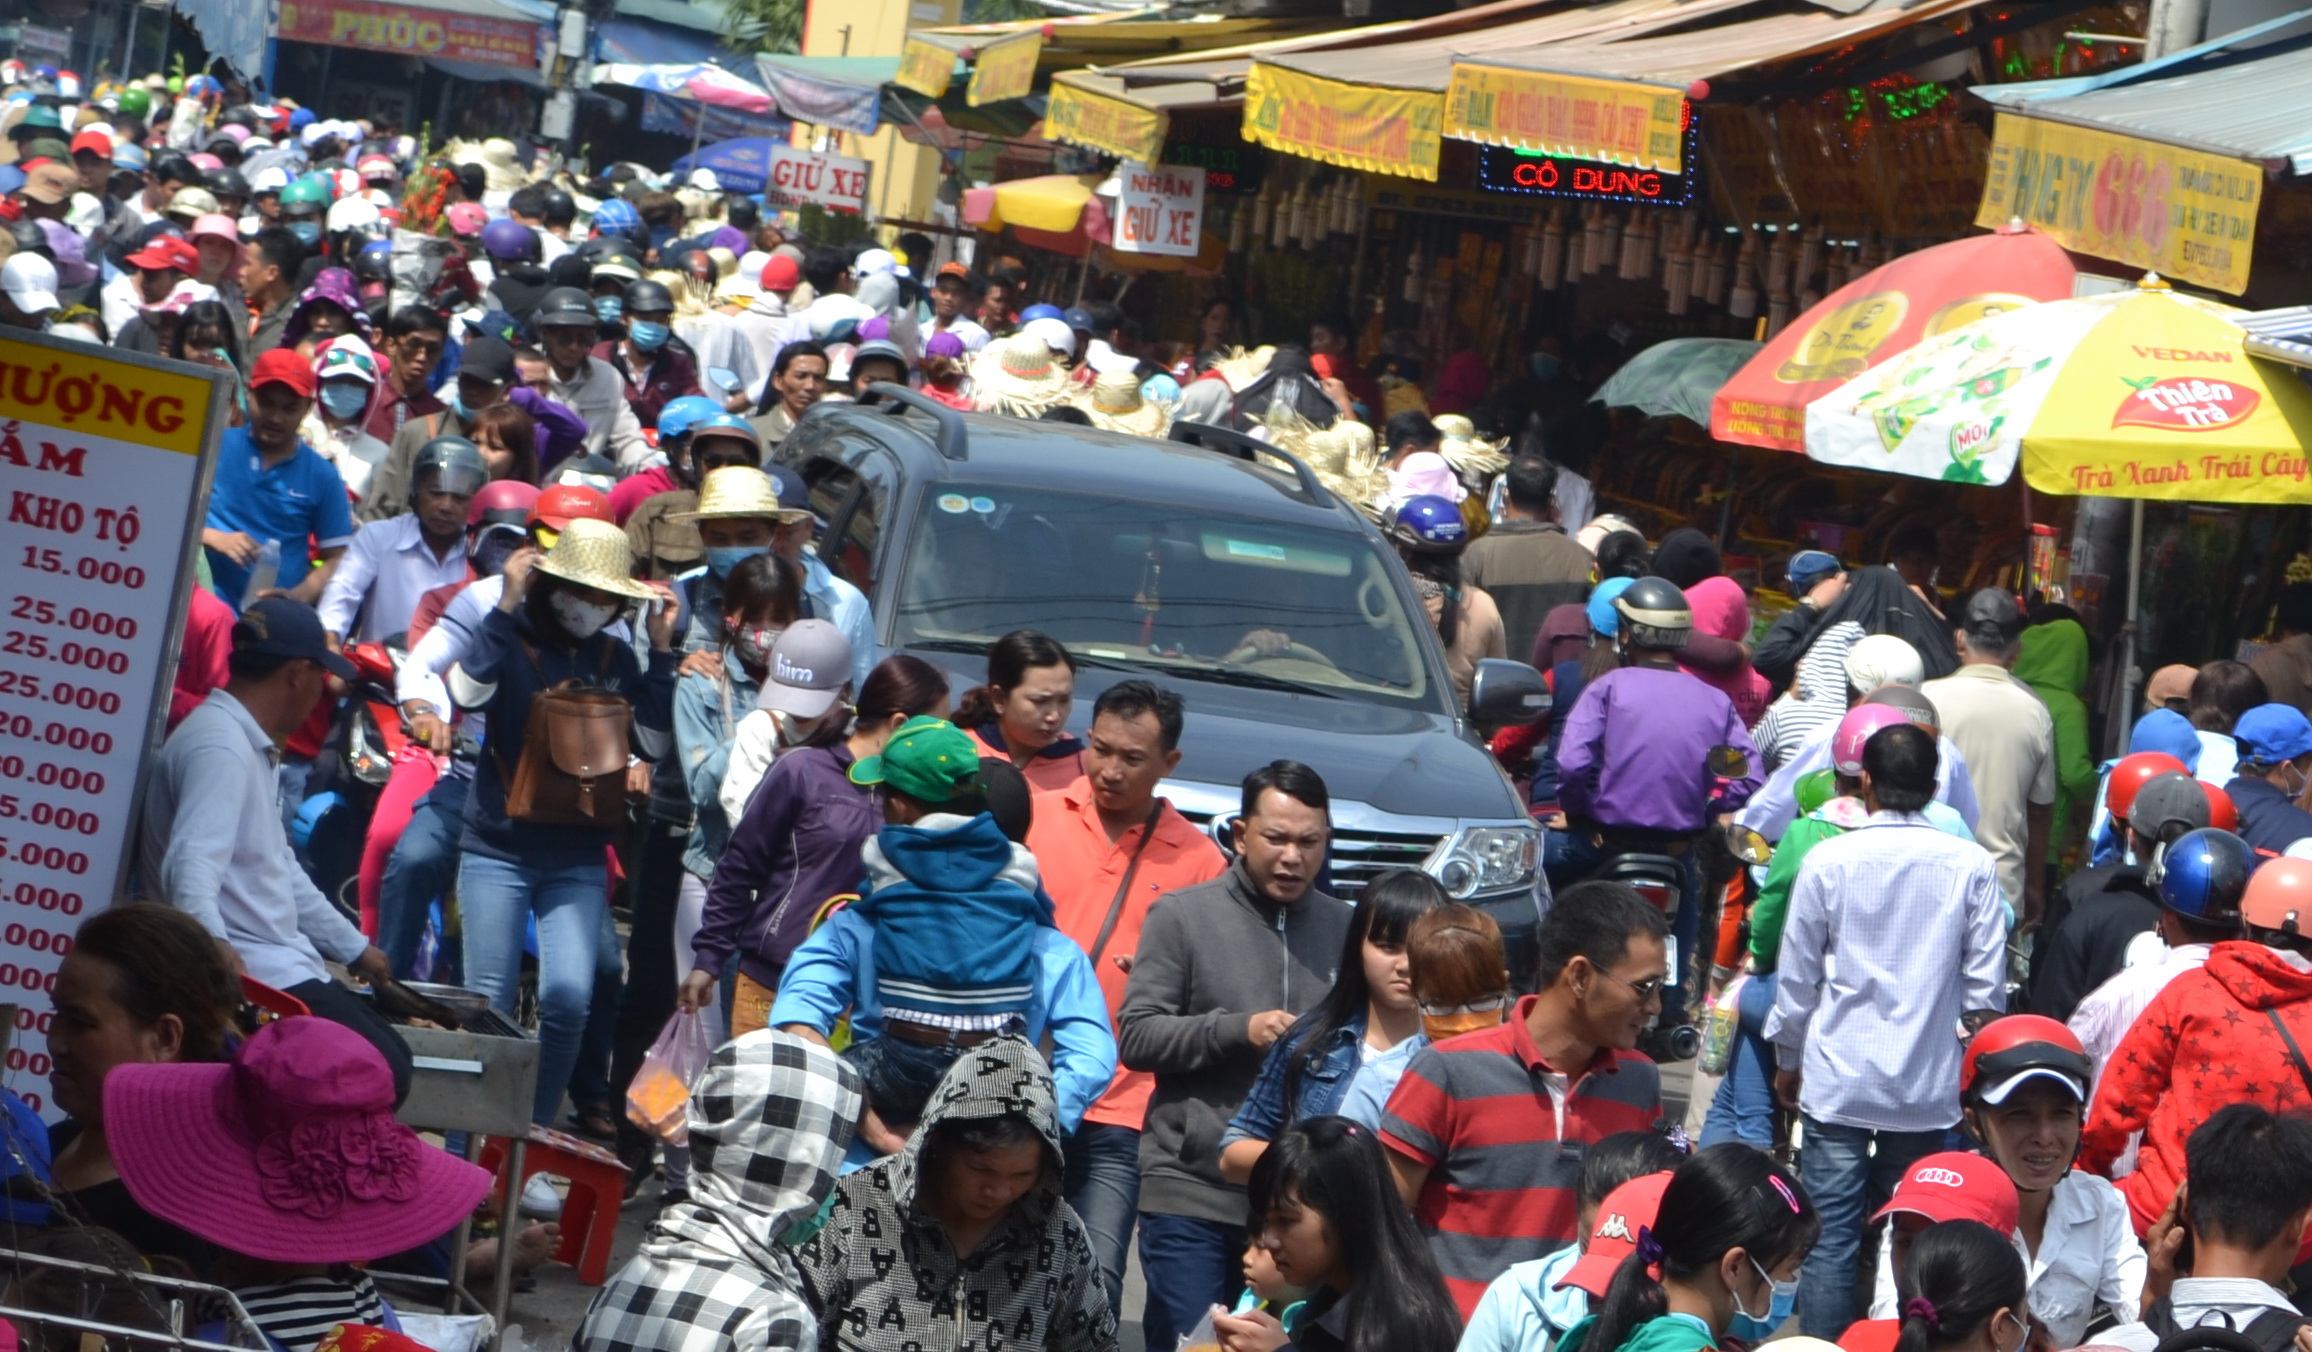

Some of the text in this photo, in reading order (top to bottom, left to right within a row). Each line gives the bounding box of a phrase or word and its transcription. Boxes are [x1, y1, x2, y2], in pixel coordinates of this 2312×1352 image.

[331, 8, 447, 51] PHÚC
[773, 157, 827, 192] GIỮ
[829, 167, 869, 199] XE
[1130, 171, 1194, 200] NHẬN
[1513, 160, 1662, 196] CÔ DUNG
[1123, 197, 1196, 246] GIỮ XE
[2093, 150, 2173, 253] 666
[2131, 344, 2233, 363] VEDAN
[2136, 379, 2234, 412] Thiên
[2174, 402, 2231, 427] Trà
[2070, 451, 2309, 490] Trà Xanh Trái Cây
[8, 491, 141, 551] KHO TỘ
[21, 545, 146, 589] 15.000
[10, 595, 138, 640] 25.000
[2, 631, 130, 675] 25.000
[775, 652, 814, 682] him
[0, 755, 105, 795] 0.000
